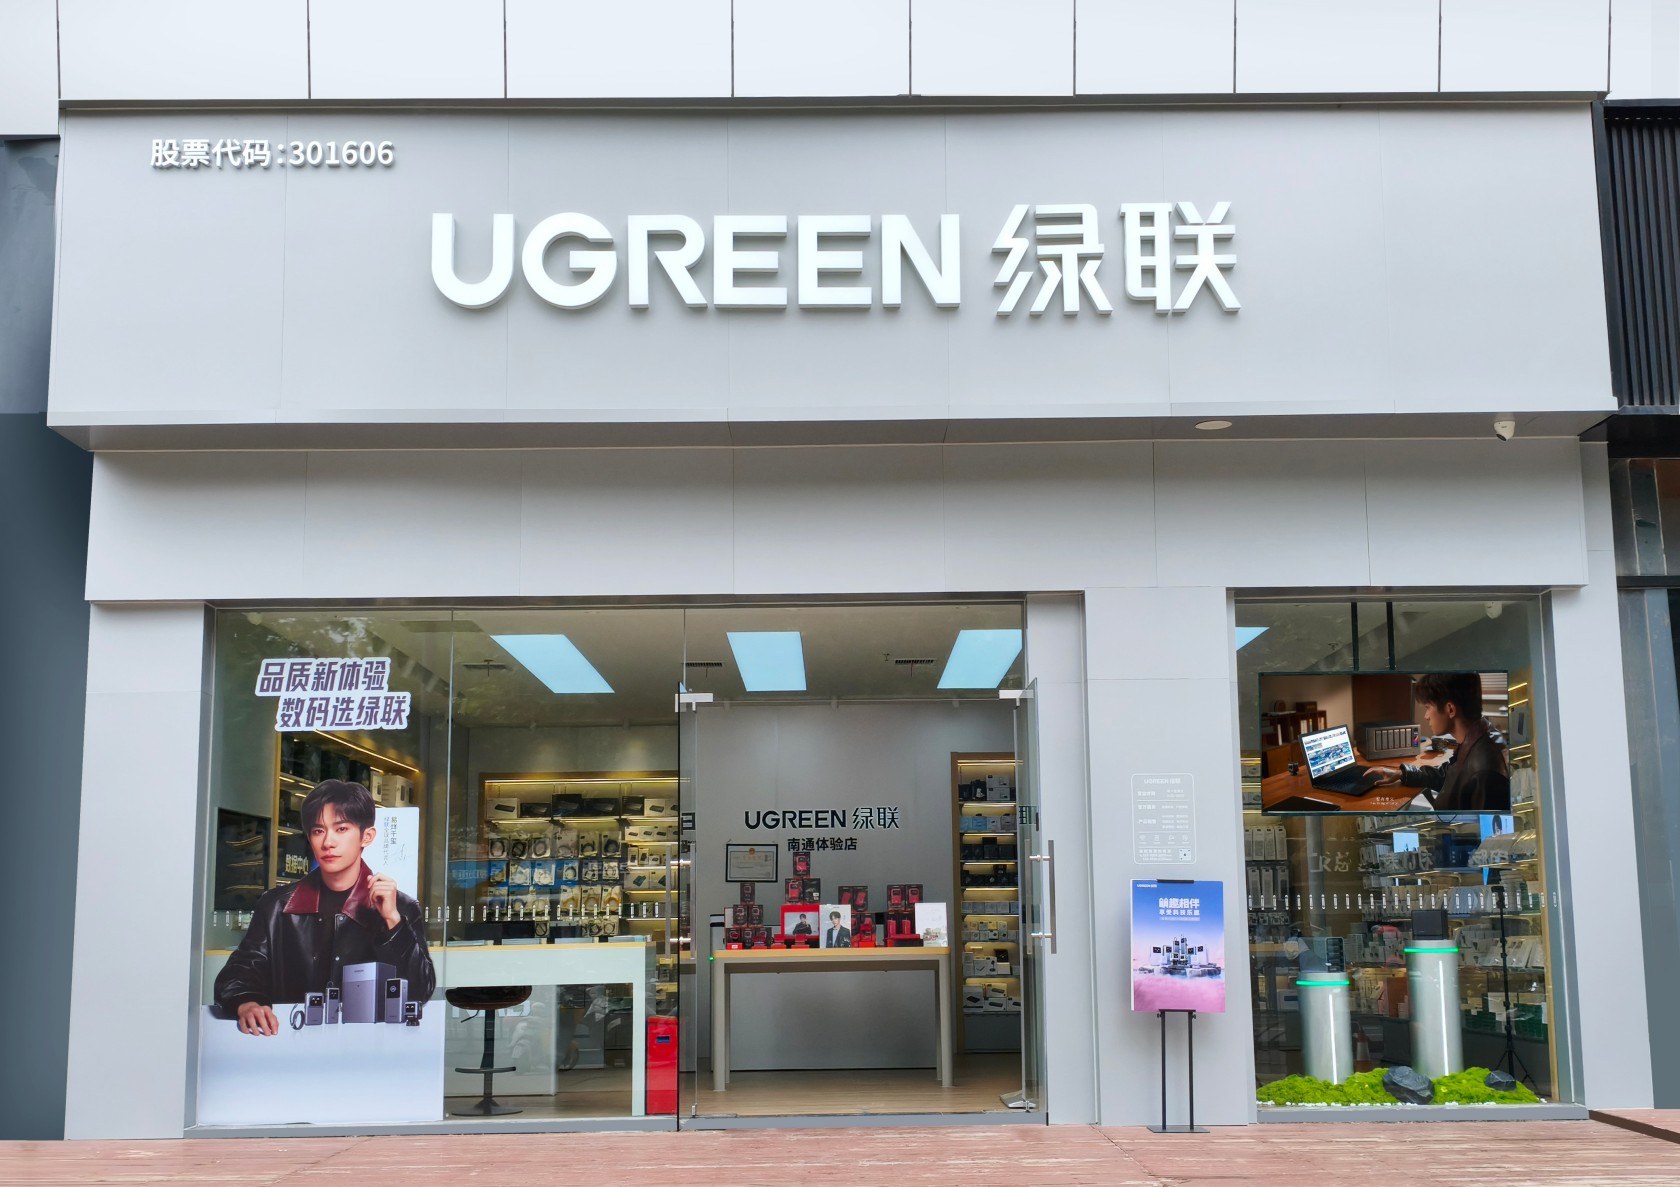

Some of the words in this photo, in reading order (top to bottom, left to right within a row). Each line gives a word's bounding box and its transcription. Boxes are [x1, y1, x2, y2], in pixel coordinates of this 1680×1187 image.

[150, 138, 394, 168] 股票代码:301606
[431, 212, 962, 310] UGREEN
[992, 201, 1242, 316] 绿联
[259, 661, 387, 692] 品质新体验
[280, 696, 407, 727] 数码选绿联
[745, 810, 847, 829] UGREEN
[852, 807, 899, 829] 绿联
[787, 837, 858, 851] 南通体验店
